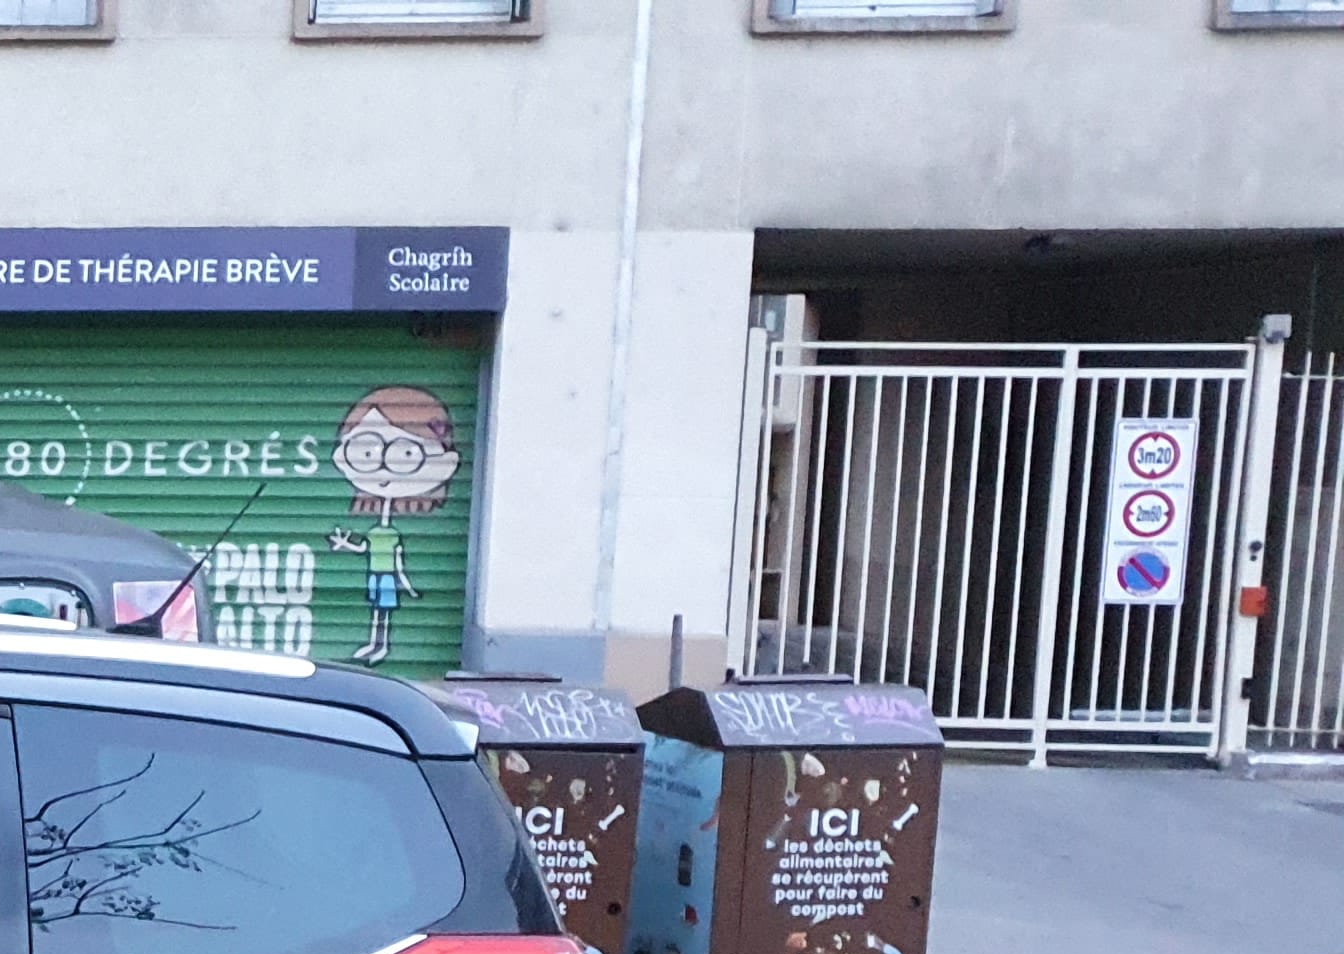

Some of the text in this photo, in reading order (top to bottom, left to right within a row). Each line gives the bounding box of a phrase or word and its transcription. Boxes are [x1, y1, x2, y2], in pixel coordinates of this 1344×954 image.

[33, 260, 71, 284] DE
[78, 253, 218, 284] THÉRAPIE
[226, 253, 320, 284] BRÈVE
[388, 246, 473, 271] Chagrin
[389, 272, 470, 292] Scolaire
[104, 430, 320, 477] DEGRÉS
[1137, 447, 1172, 464] 3m20
[214, 541, 316, 604] PALO
[810, 808, 860, 837] ICI
[784, 838, 882, 854] les déchets
[779, 853, 884, 869] alimentaires
[772, 872, 792, 885] se
[565, 886, 587, 900] du
[775, 885, 884, 905] pour faire du
[791, 902, 864, 918] compost
